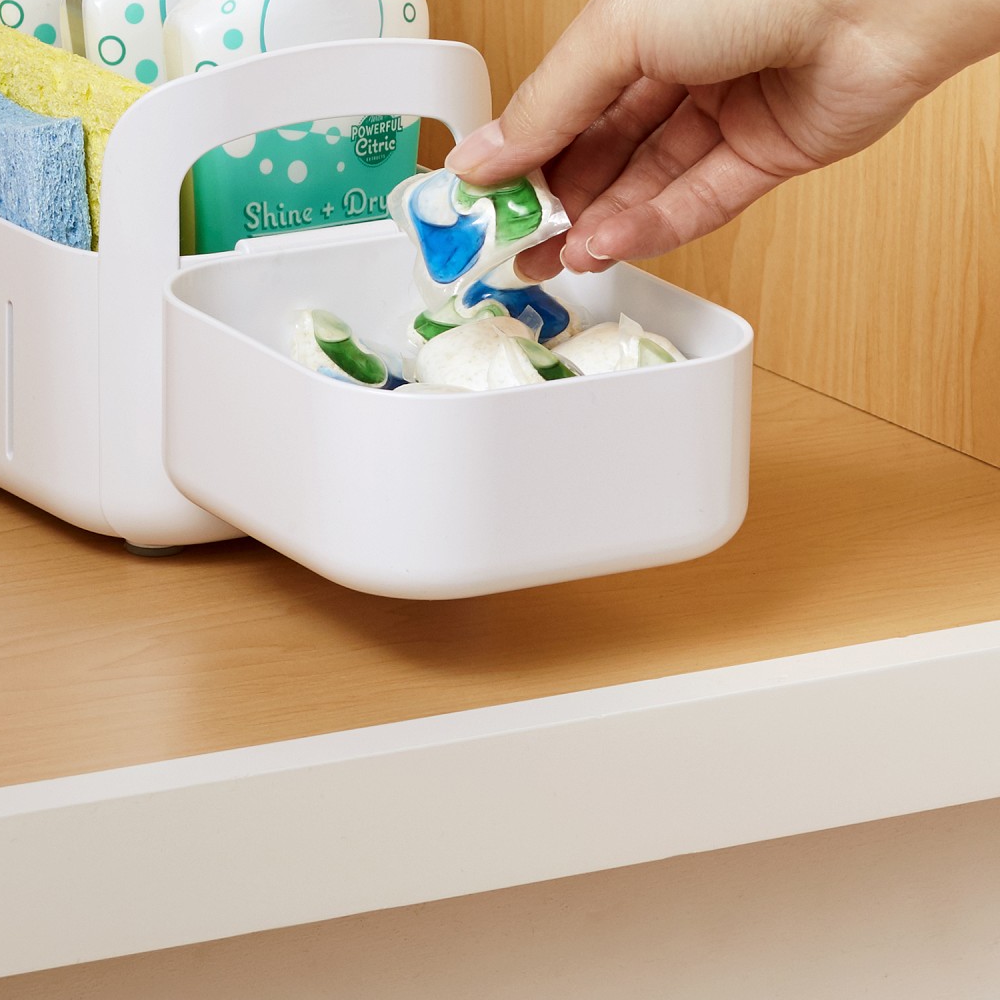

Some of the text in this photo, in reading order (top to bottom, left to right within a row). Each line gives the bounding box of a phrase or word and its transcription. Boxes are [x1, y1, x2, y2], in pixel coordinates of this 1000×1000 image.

[351, 116, 402, 141] POWERFUL
[355, 136, 396, 156] Citric
[244, 187, 389, 230] Shine + Dry
